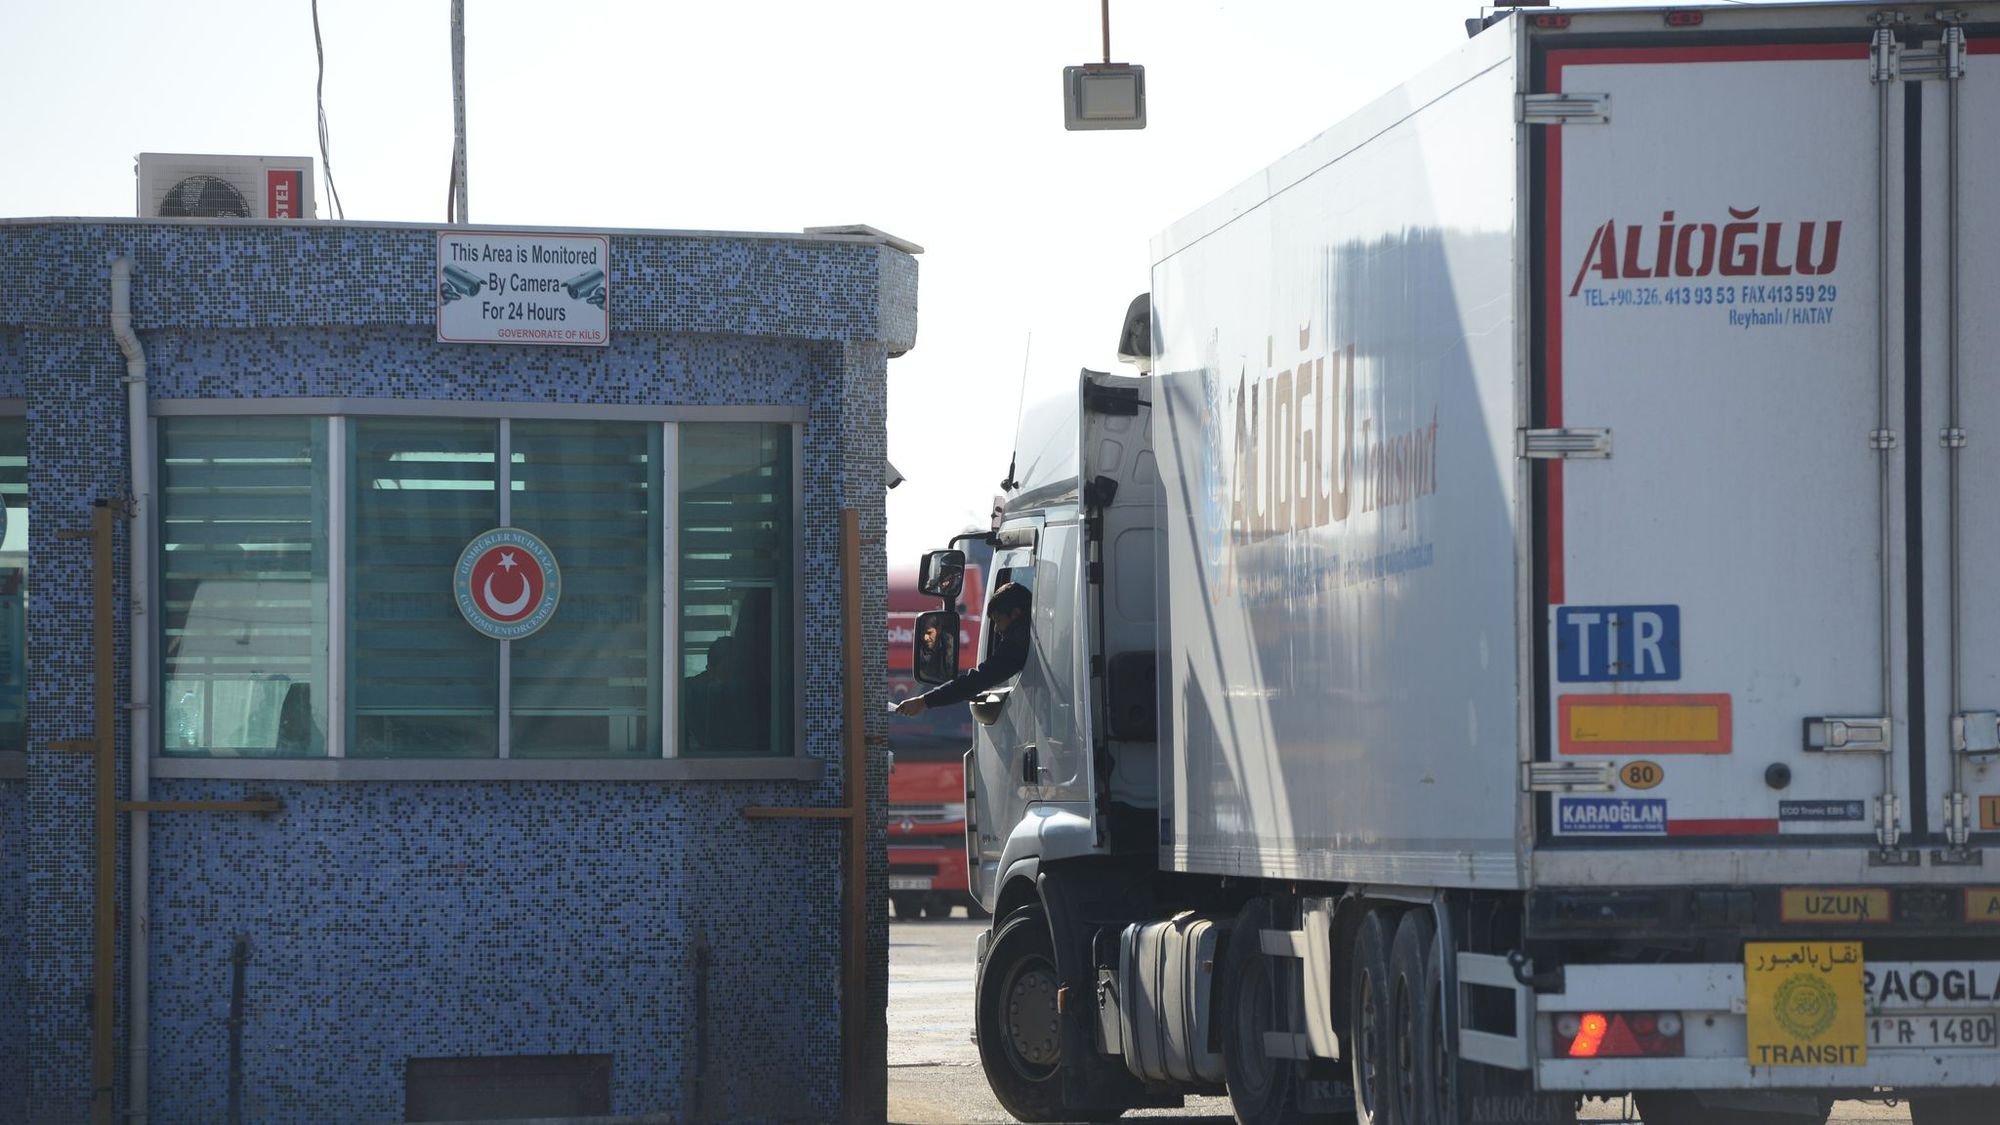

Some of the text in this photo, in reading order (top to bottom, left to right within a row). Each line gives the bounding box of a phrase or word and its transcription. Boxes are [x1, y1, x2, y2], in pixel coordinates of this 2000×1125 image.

[450, 242, 597, 265] This Area is Monitored
[489, 272, 560, 296] By Camera
[1665, 286, 1691, 305] 413
[1694, 286, 1713, 305] 93
[1716, 286, 1736, 304] 53
[1742, 285, 1766, 303] FAX
[1767, 284, 1793, 303] 413
[1795, 284, 1815, 303] 59
[1817, 284, 1837, 302] 29
[482, 301, 566, 321] For 24 Hours
[1792, 306, 1834, 325] HATAY
[497, 328, 563, 339] GOVERNORATE
[565, 329, 577, 339] OF
[1361, 403, 1439, 531] Transport
[459, 593, 555, 636] CUSTOMS ENFORCEMENT
[1567, 611, 1667, 676] TIR
[1629, 765, 1654, 784] 80
[1562, 801, 1664, 823] KARAOĞLAN
[1805, 895, 1870, 915] UZUN
[1864, 968, 2000, 1002] RAOGL
[1897, 1019, 1914, 1044] R
[1929, 1018, 1992, 1043] 1480
[1757, 1045, 1860, 1064] TRANSIT
